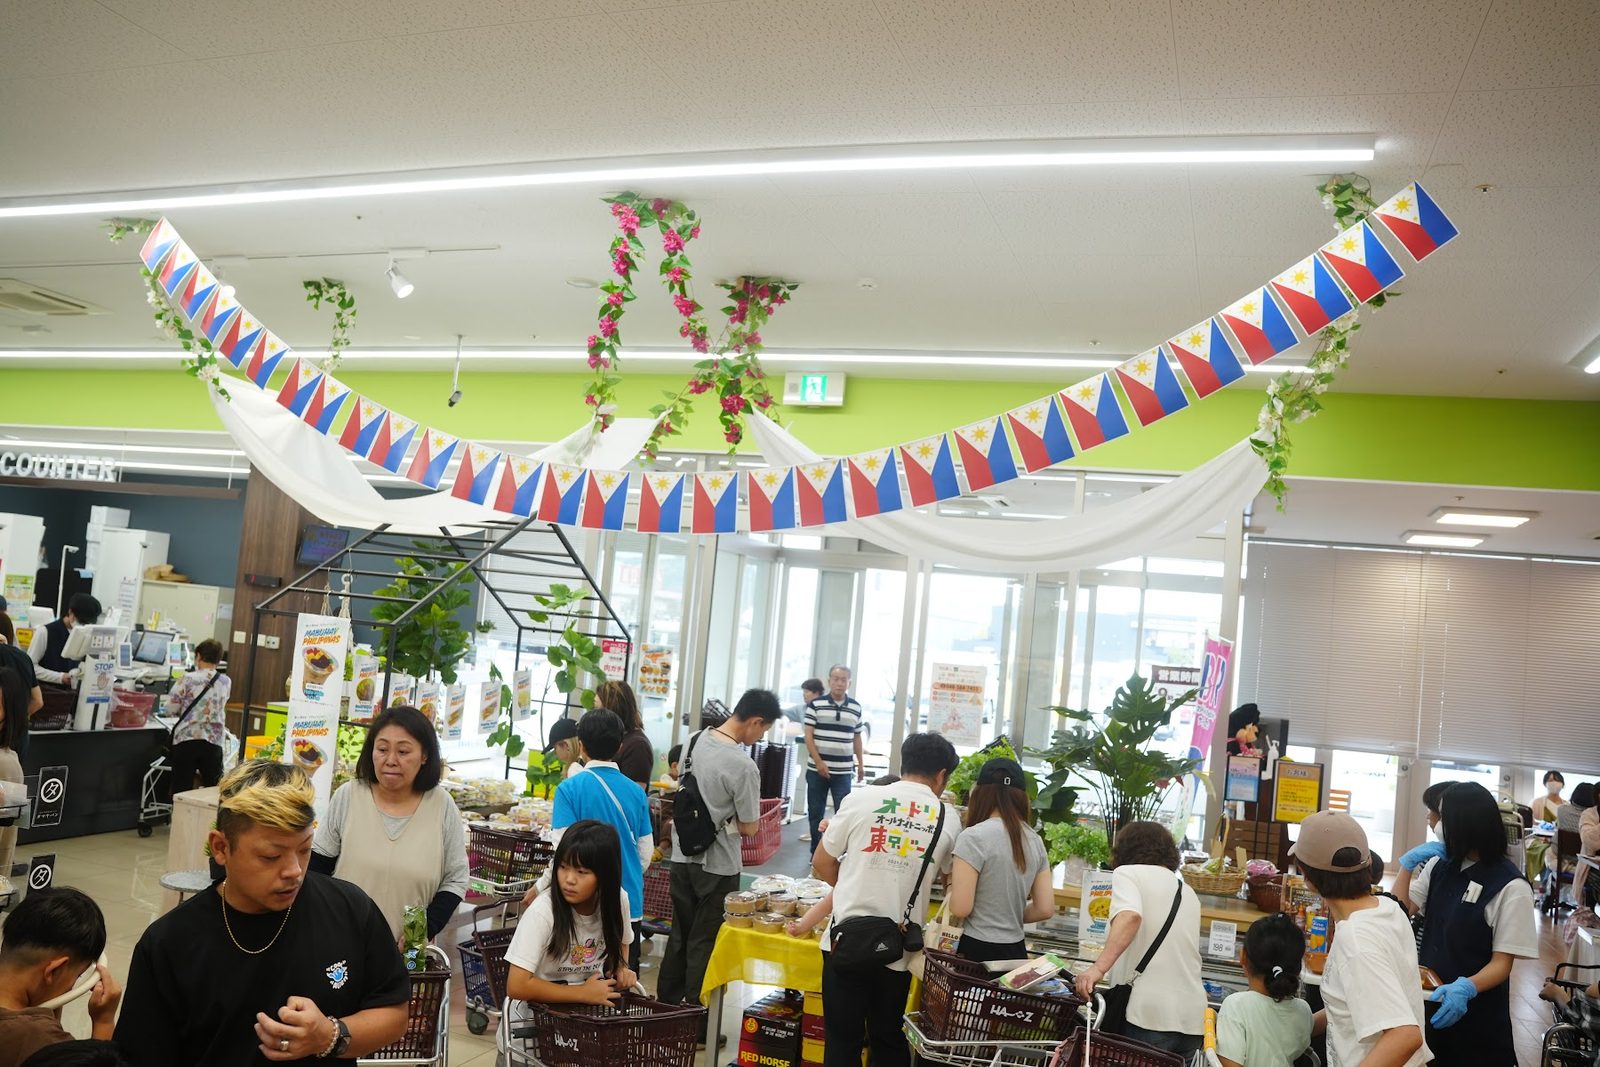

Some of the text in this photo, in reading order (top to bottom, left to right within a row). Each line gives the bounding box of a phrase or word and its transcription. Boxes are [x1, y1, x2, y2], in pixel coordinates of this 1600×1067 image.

[0, 452, 117, 482] COUNTER
[95, 663, 113, 672] STOP
[872, 797, 939, 822] オードリ
[875, 814, 935, 834] オールナイトニッポ
[941, 932, 959, 940] HELLO
[741, 1050, 791, 1067] RED HORSE
